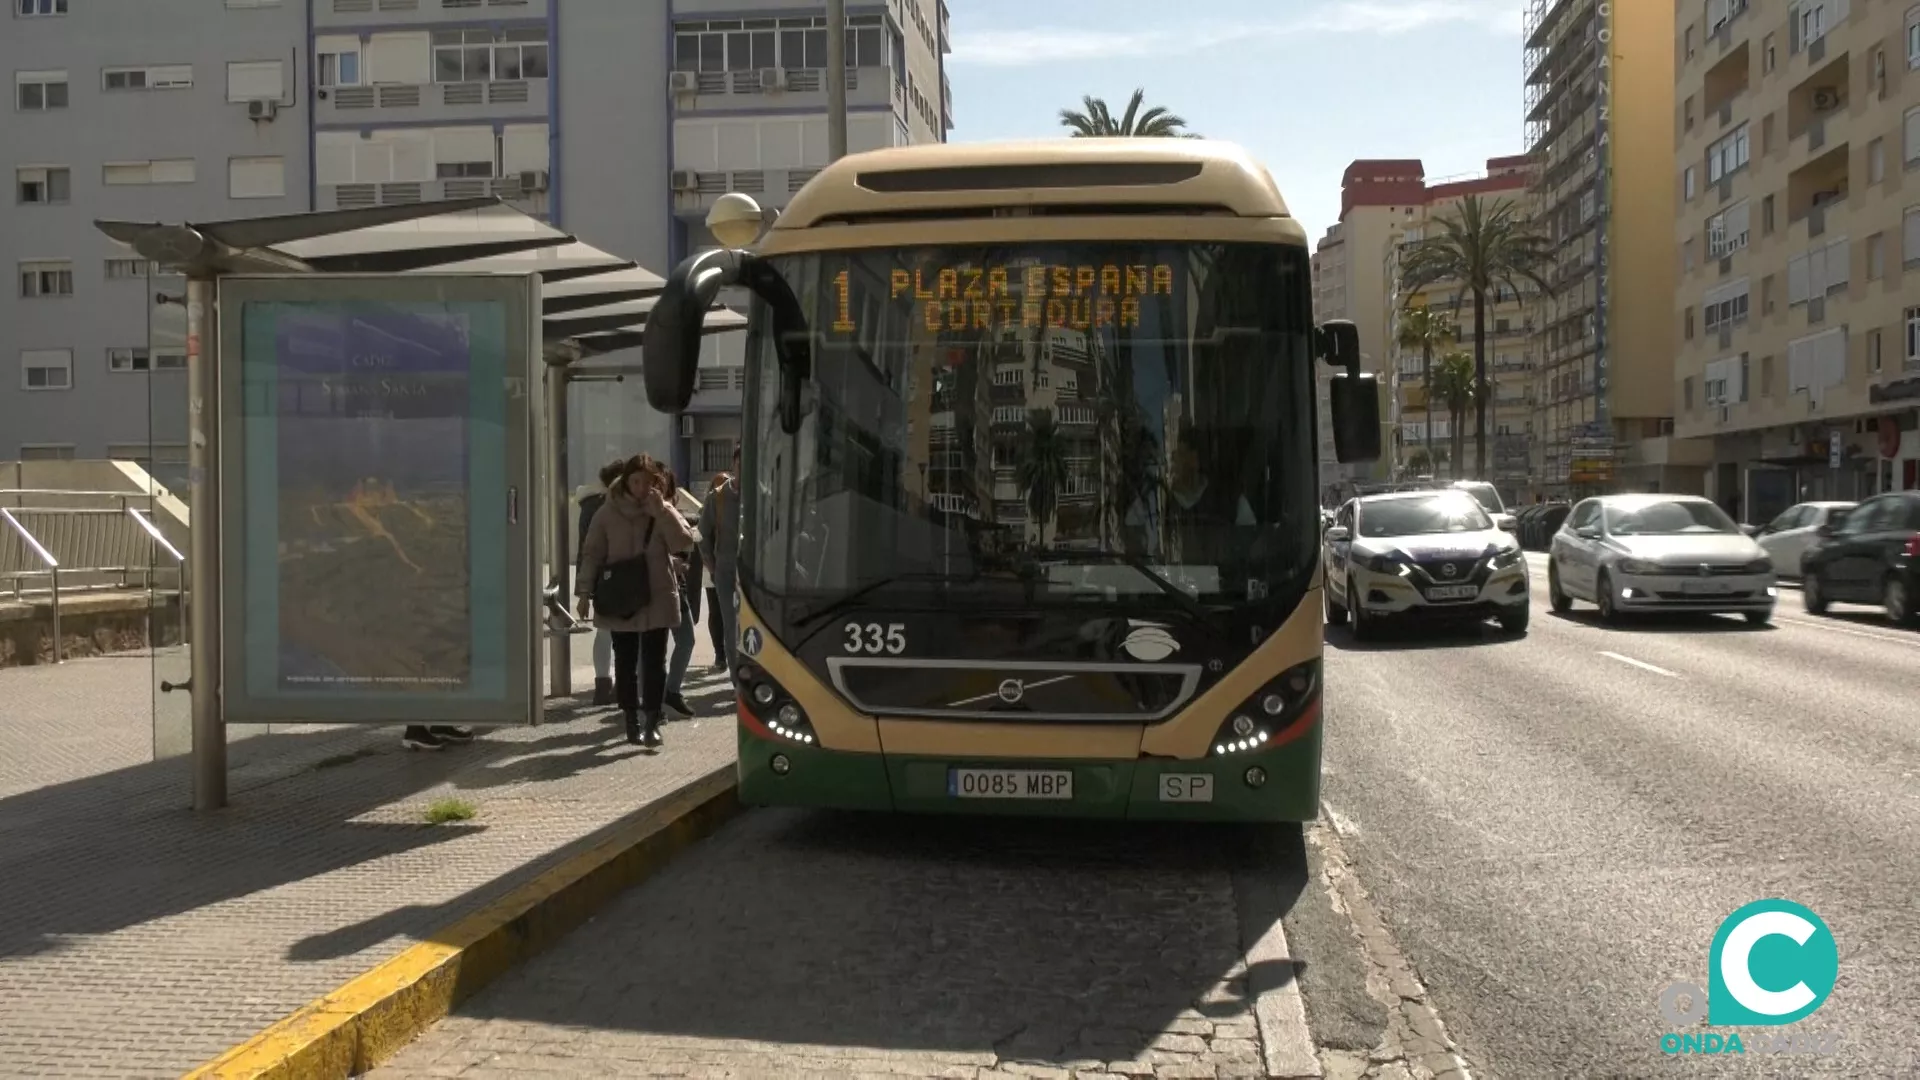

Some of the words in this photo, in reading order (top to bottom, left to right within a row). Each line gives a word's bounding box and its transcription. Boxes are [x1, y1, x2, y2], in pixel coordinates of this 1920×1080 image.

[1598, 3, 1611, 147] COANZA
[891, 267, 1008, 299] PLAZA
[1027, 263, 1172, 298] ESPAÑA
[833, 269, 856, 332] 1
[924, 297, 1140, 332] CORTADURA
[844, 623, 907, 655] 335
[962, 771, 1018, 795] 0085
[1027, 771, 1069, 795] MBP
[1165, 775, 1206, 798] SP
